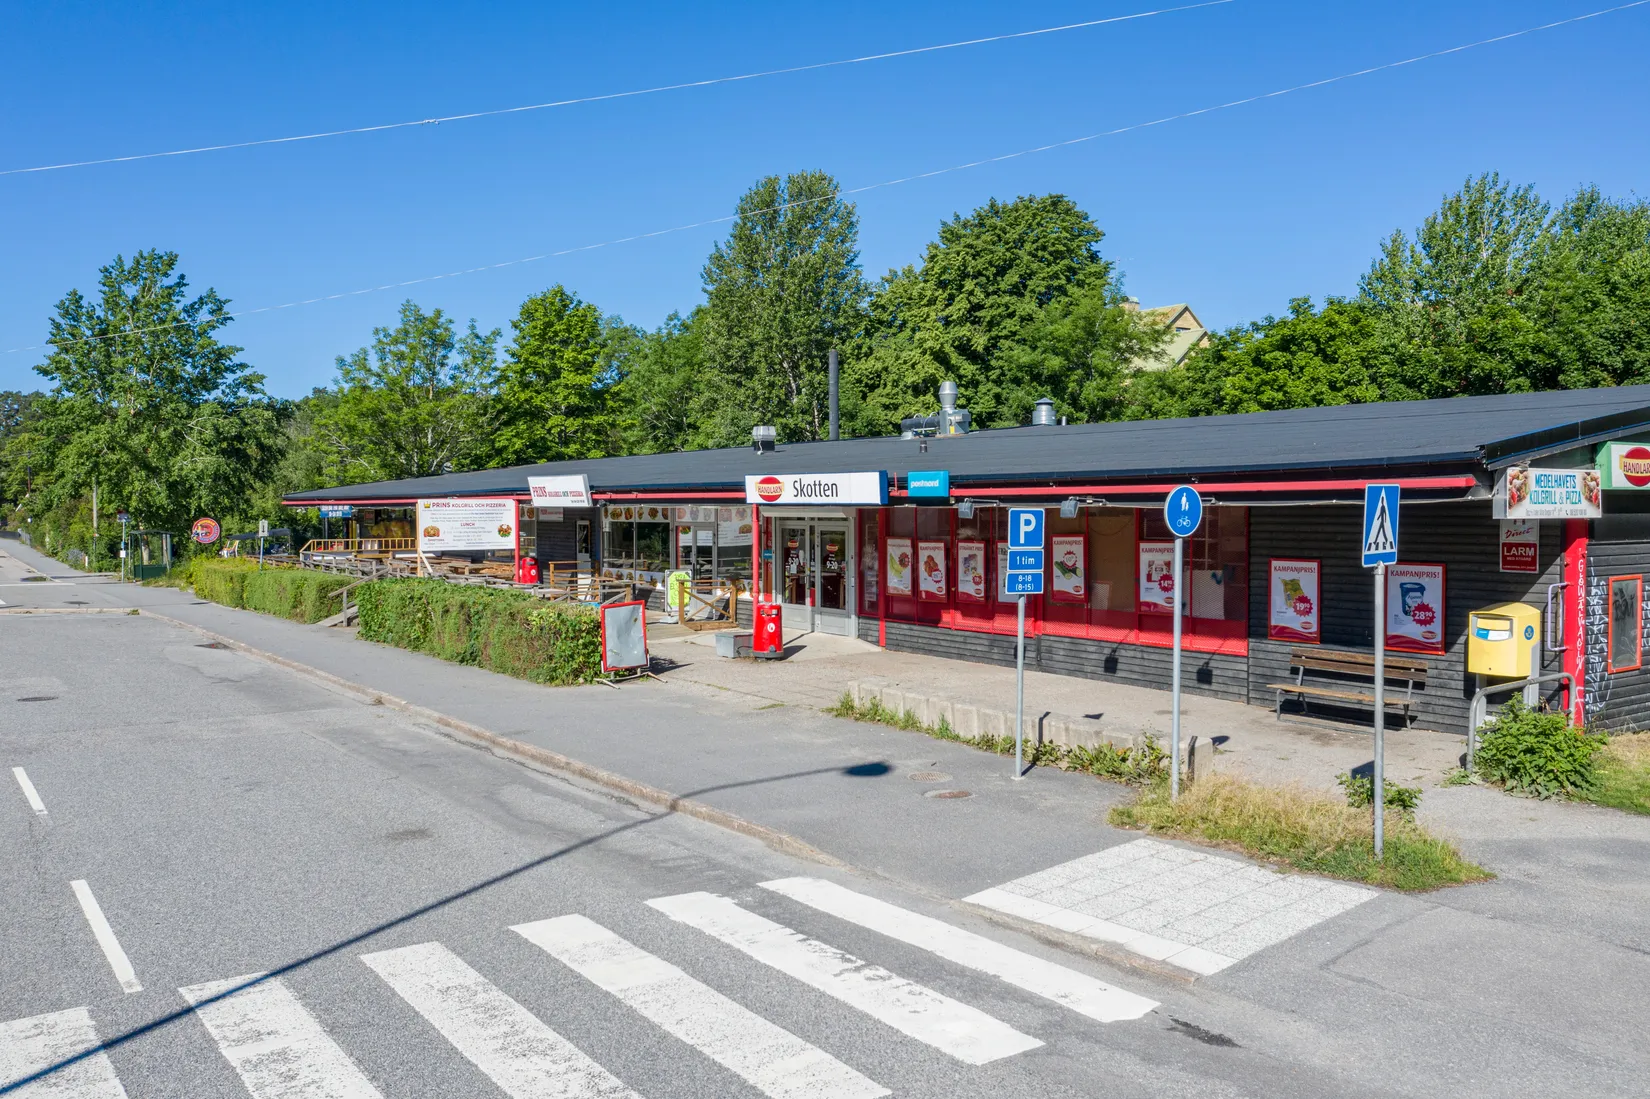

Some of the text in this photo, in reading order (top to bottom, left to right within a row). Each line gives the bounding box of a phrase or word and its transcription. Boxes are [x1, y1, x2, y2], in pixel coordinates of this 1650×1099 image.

[910, 479, 939, 489] postnord
[1534, 473, 1577, 489] MEDELHAVETS
[531, 486, 548, 498] PRINS
[793, 477, 839, 498] Skotten
[1529, 490, 1582, 505] KOLGRILL & PIZZA
[1019, 513, 1036, 544] P
[1504, 527, 1534, 539] Direct
[1503, 546, 1535, 556] LARM
[1016, 555, 1035, 565] 1 tim
[1273, 565, 1316, 575] KAMPANJPRIS!
[1390, 569, 1440, 579] KAMPANJPRIS!
[1017, 574, 1032, 582] 8-18
[1015, 583, 1034, 591] (8-15)
